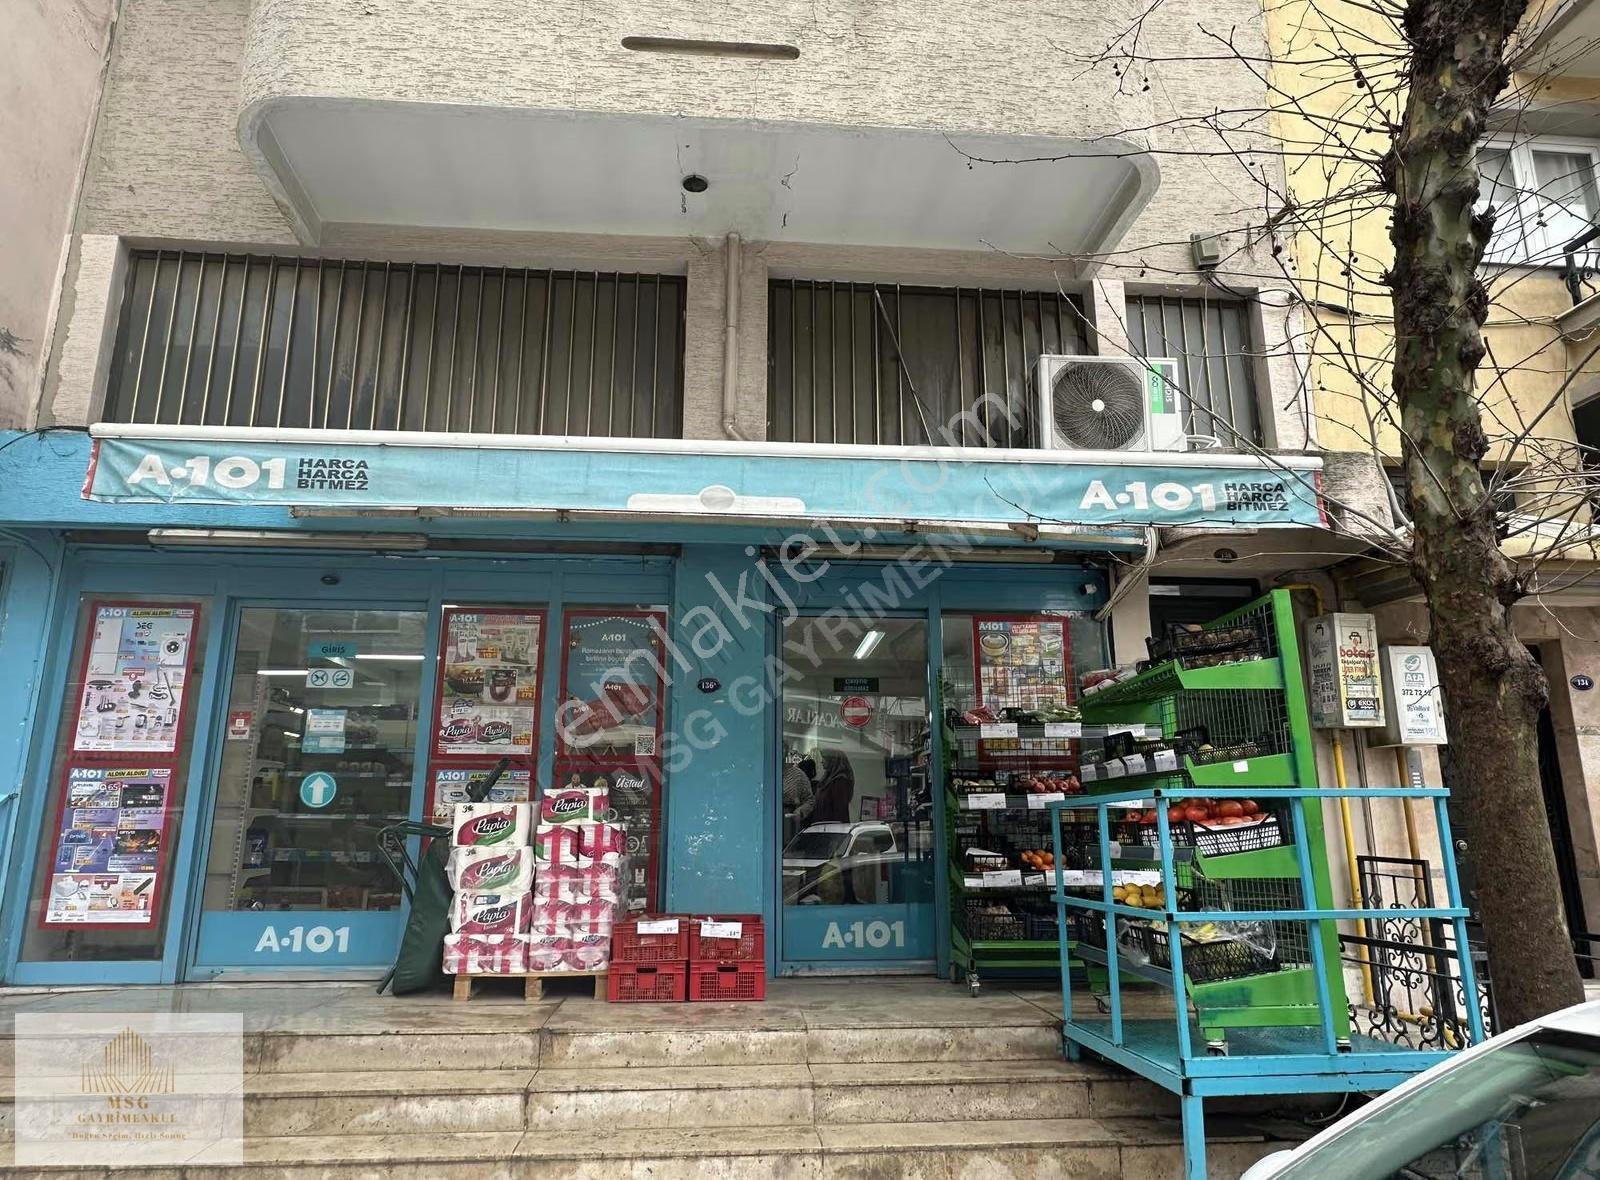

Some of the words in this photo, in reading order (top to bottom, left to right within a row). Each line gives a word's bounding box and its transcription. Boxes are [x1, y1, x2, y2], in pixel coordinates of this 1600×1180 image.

[299, 458, 369, 470] HARCA
[298, 469, 369, 480] HARCA
[1224, 482, 1286, 493] HARCA
[1227, 492, 1285, 502] HARCA
[1402, 688, 1414, 696] 372
[615, 775, 645, 788] Üstad
[553, 797, 584, 813] Papia
[475, 817, 508, 834] Papia
[478, 861, 512, 878] Papia
[475, 906, 508, 924] Papia
